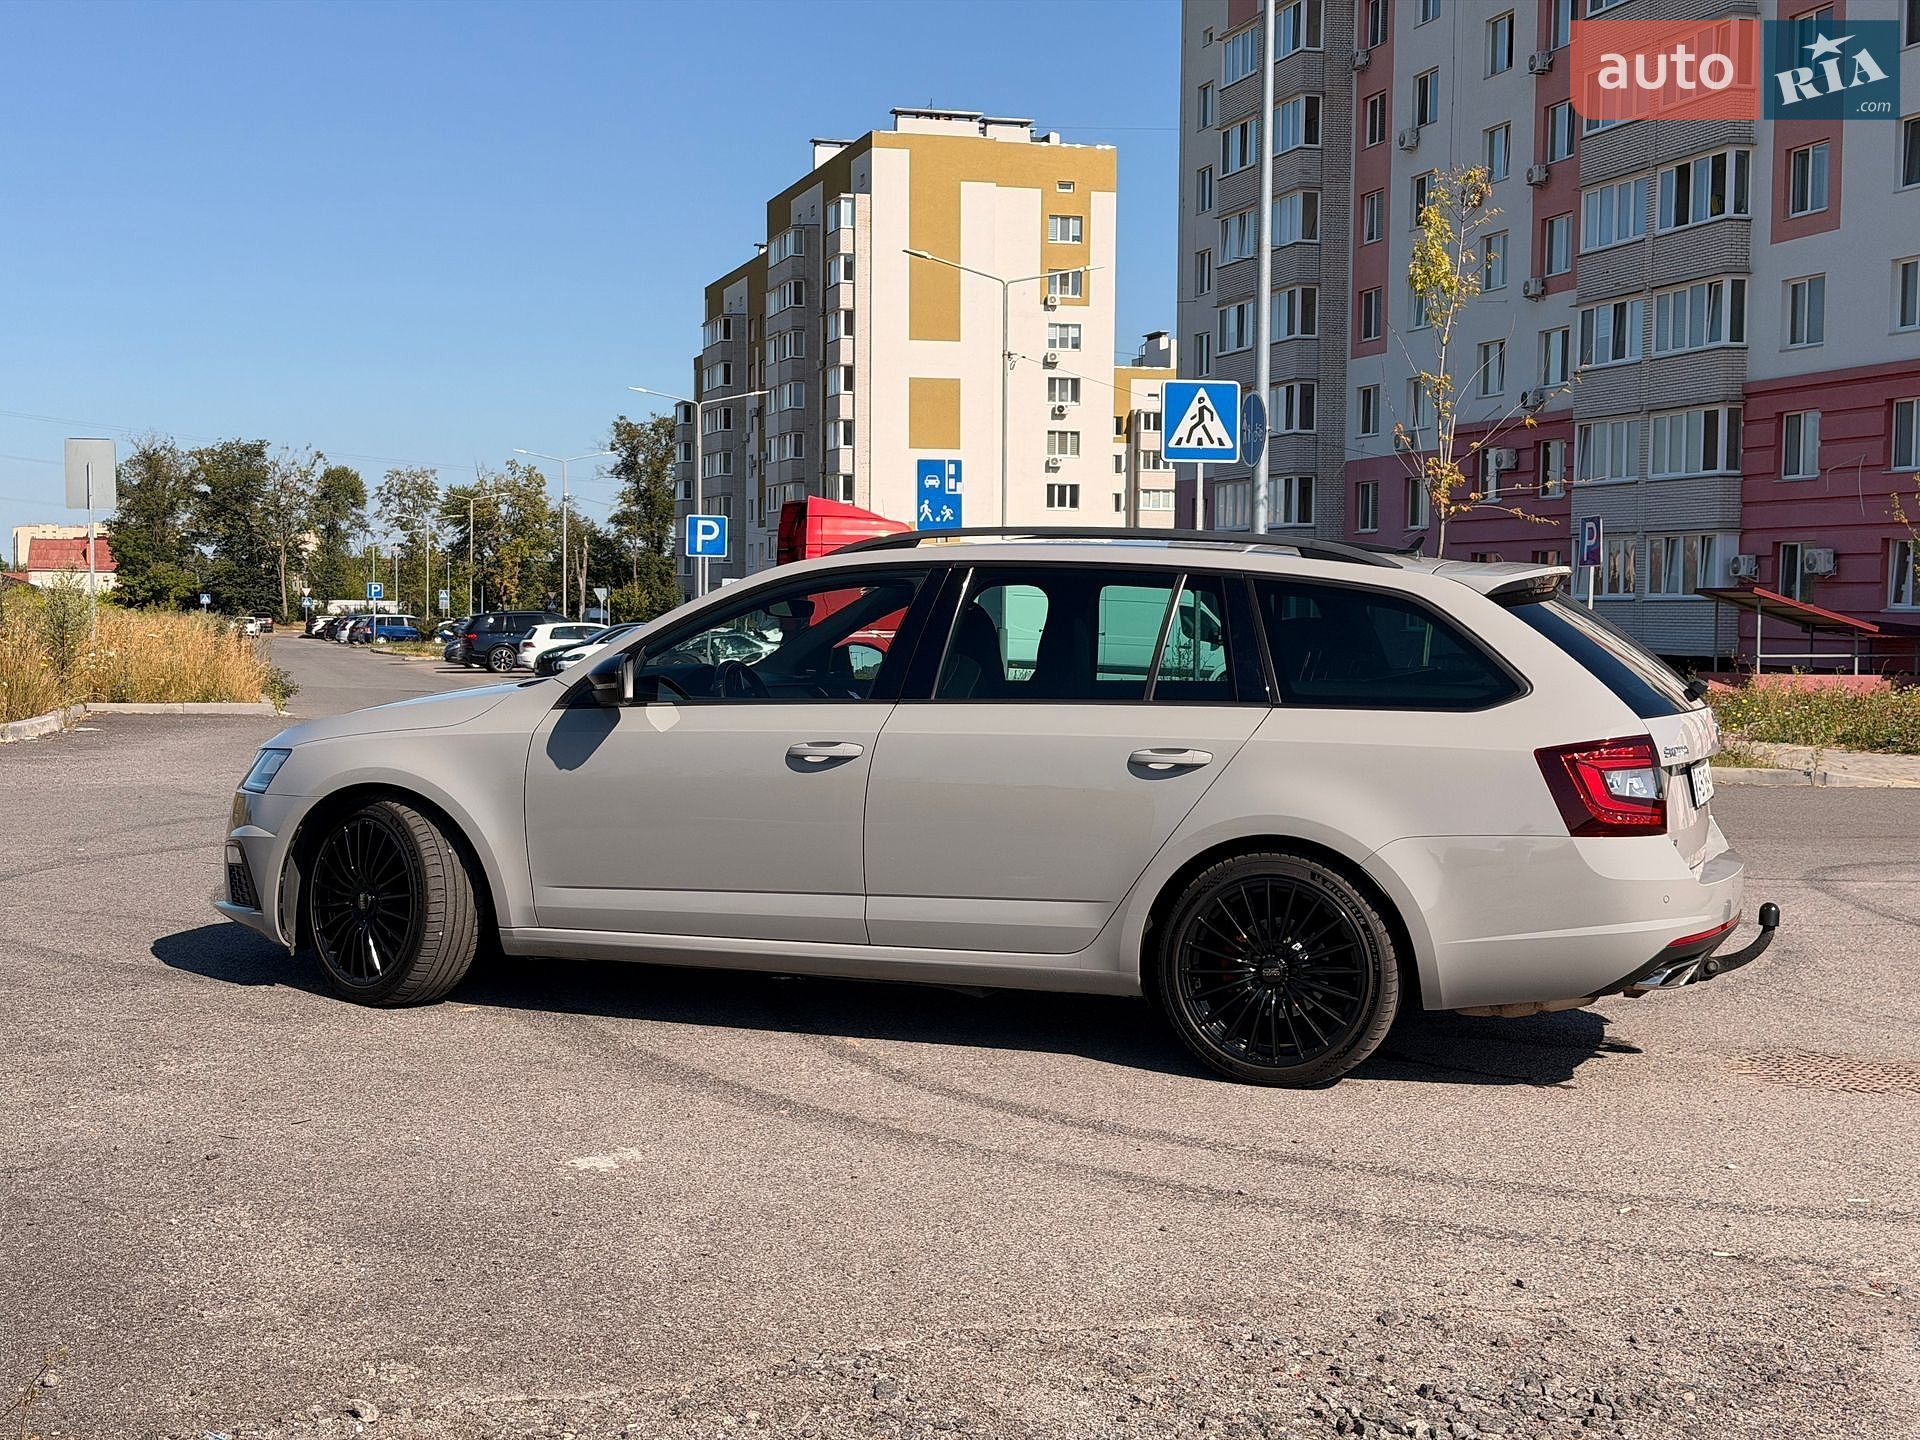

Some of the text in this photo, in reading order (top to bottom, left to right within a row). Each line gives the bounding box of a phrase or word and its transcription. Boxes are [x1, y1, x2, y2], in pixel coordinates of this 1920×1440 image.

[697, 520, 720, 552] P
[1583, 521, 1597, 561] P
[372, 585, 381, 596] P
[1323, 880, 1366, 926] MICHELIN
